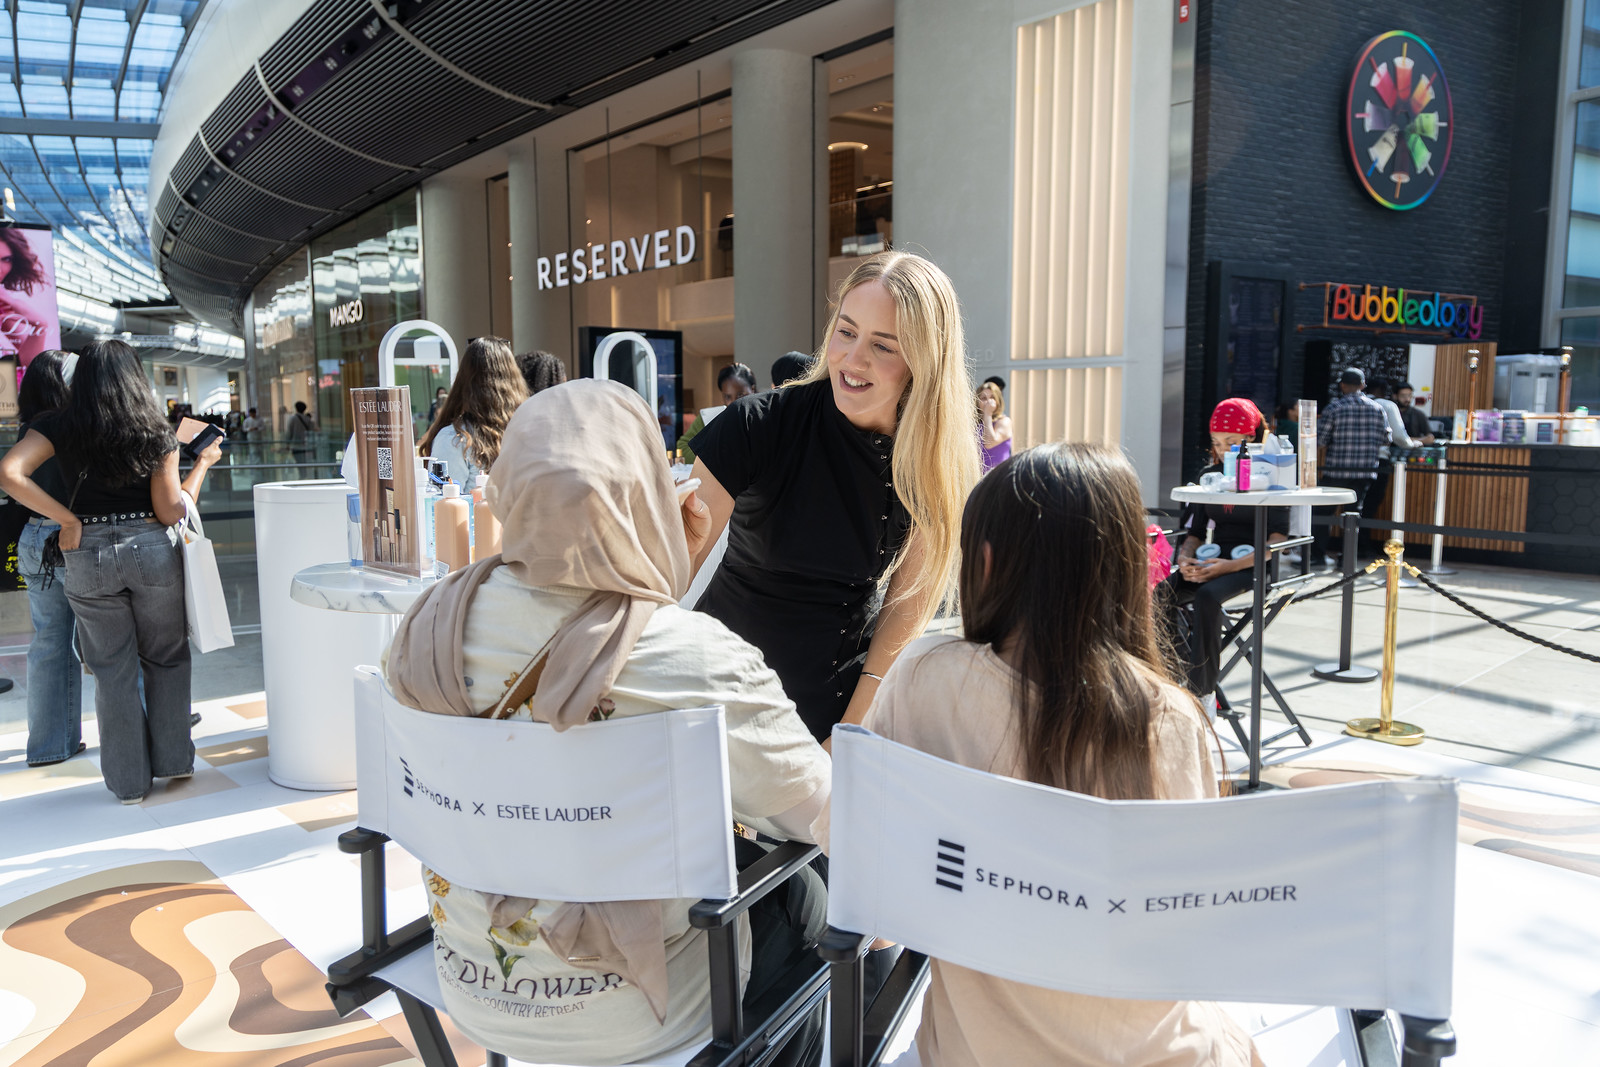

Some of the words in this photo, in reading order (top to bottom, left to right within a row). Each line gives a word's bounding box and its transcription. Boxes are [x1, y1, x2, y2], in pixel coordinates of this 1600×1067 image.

[537, 225, 696, 291] RESERVED
[329, 299, 364, 328] MANGO
[1333, 284, 1484, 340] Bubbleology
[377, 400, 403, 413] LAUDER
[416, 778, 462, 813] SEPHORA
[545, 805, 613, 823] LAUDER
[975, 867, 1089, 910] SEPHORA
[1211, 884, 1298, 906] LAUDER
[483, 996, 535, 1018] COUNTRY
[533, 1000, 586, 1018] RETREAT
